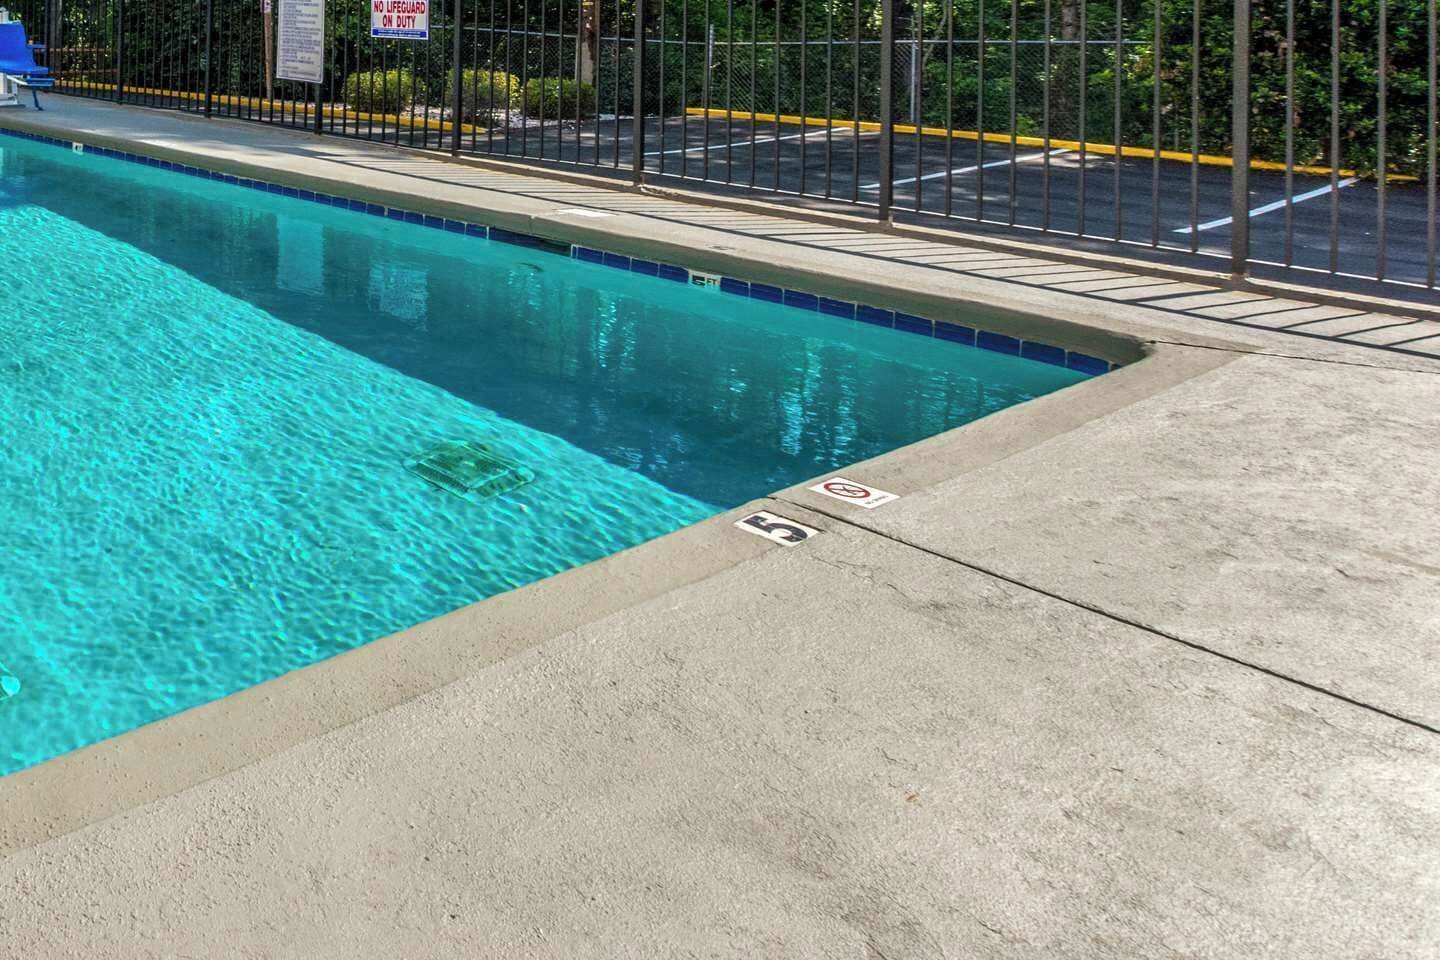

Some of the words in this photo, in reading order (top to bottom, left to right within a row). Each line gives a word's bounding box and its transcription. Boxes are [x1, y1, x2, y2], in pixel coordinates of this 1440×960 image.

[374, 0, 384, 13] NO
[386, 1, 426, 14] LIFEGUARD
[382, 14, 393, 27] ON
[396, 15, 416, 28] DUTY
[742, 514, 809, 543] 5
